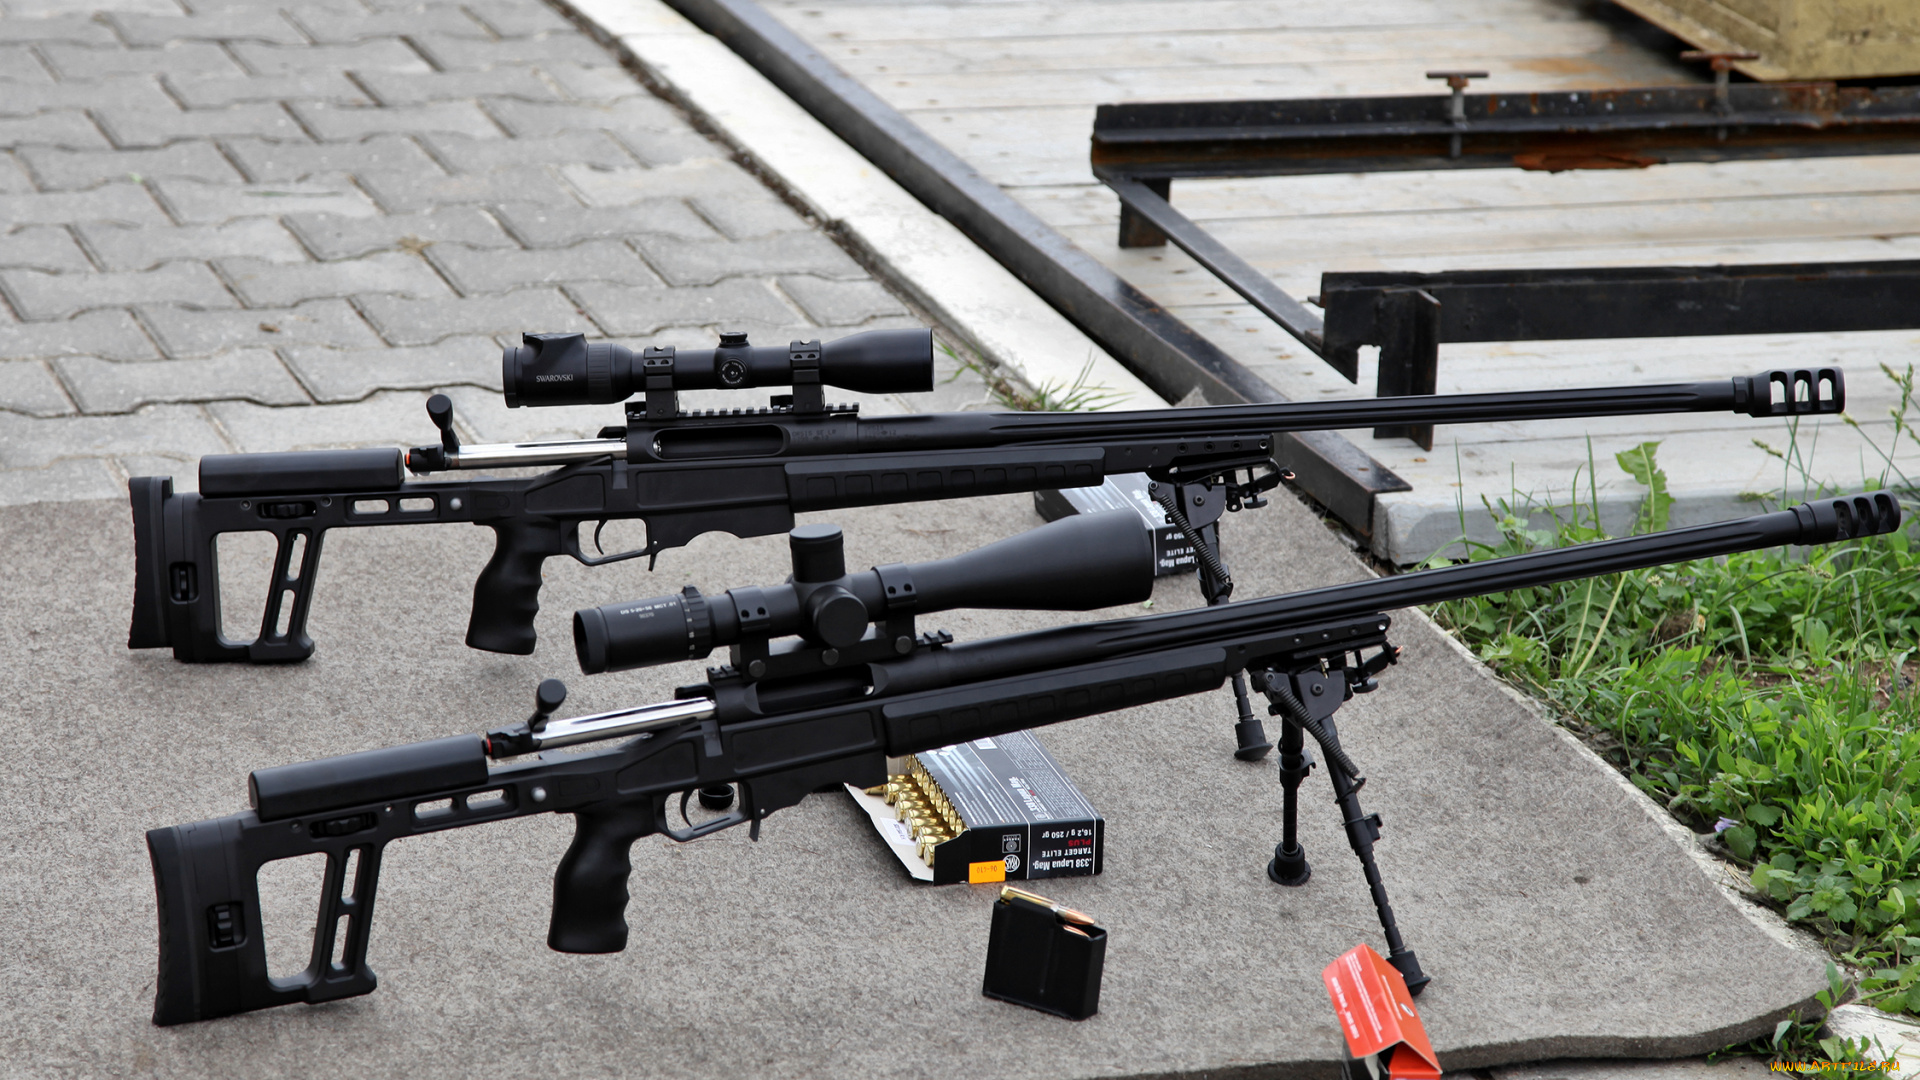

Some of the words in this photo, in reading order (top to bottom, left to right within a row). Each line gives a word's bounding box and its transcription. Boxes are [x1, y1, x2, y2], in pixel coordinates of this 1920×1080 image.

[535, 373, 574, 383] SWAROVSKI
[1166, 547, 1184, 557] ELITE
[1175, 555, 1195, 565] Lapua
[1041, 830, 1050, 839] gr
[1051, 831, 1065, 839] 250
[1077, 828, 1092, 838] 16,2
[1067, 838, 1092, 847] PLUS
[1041, 849, 1062, 858] ELITE
[1064, 847, 1092, 856] TARGET
[1032, 860, 1051, 871] Mag.
[1051, 858, 1074, 869] Lapua
[1075, 858, 1092, 868] .338
